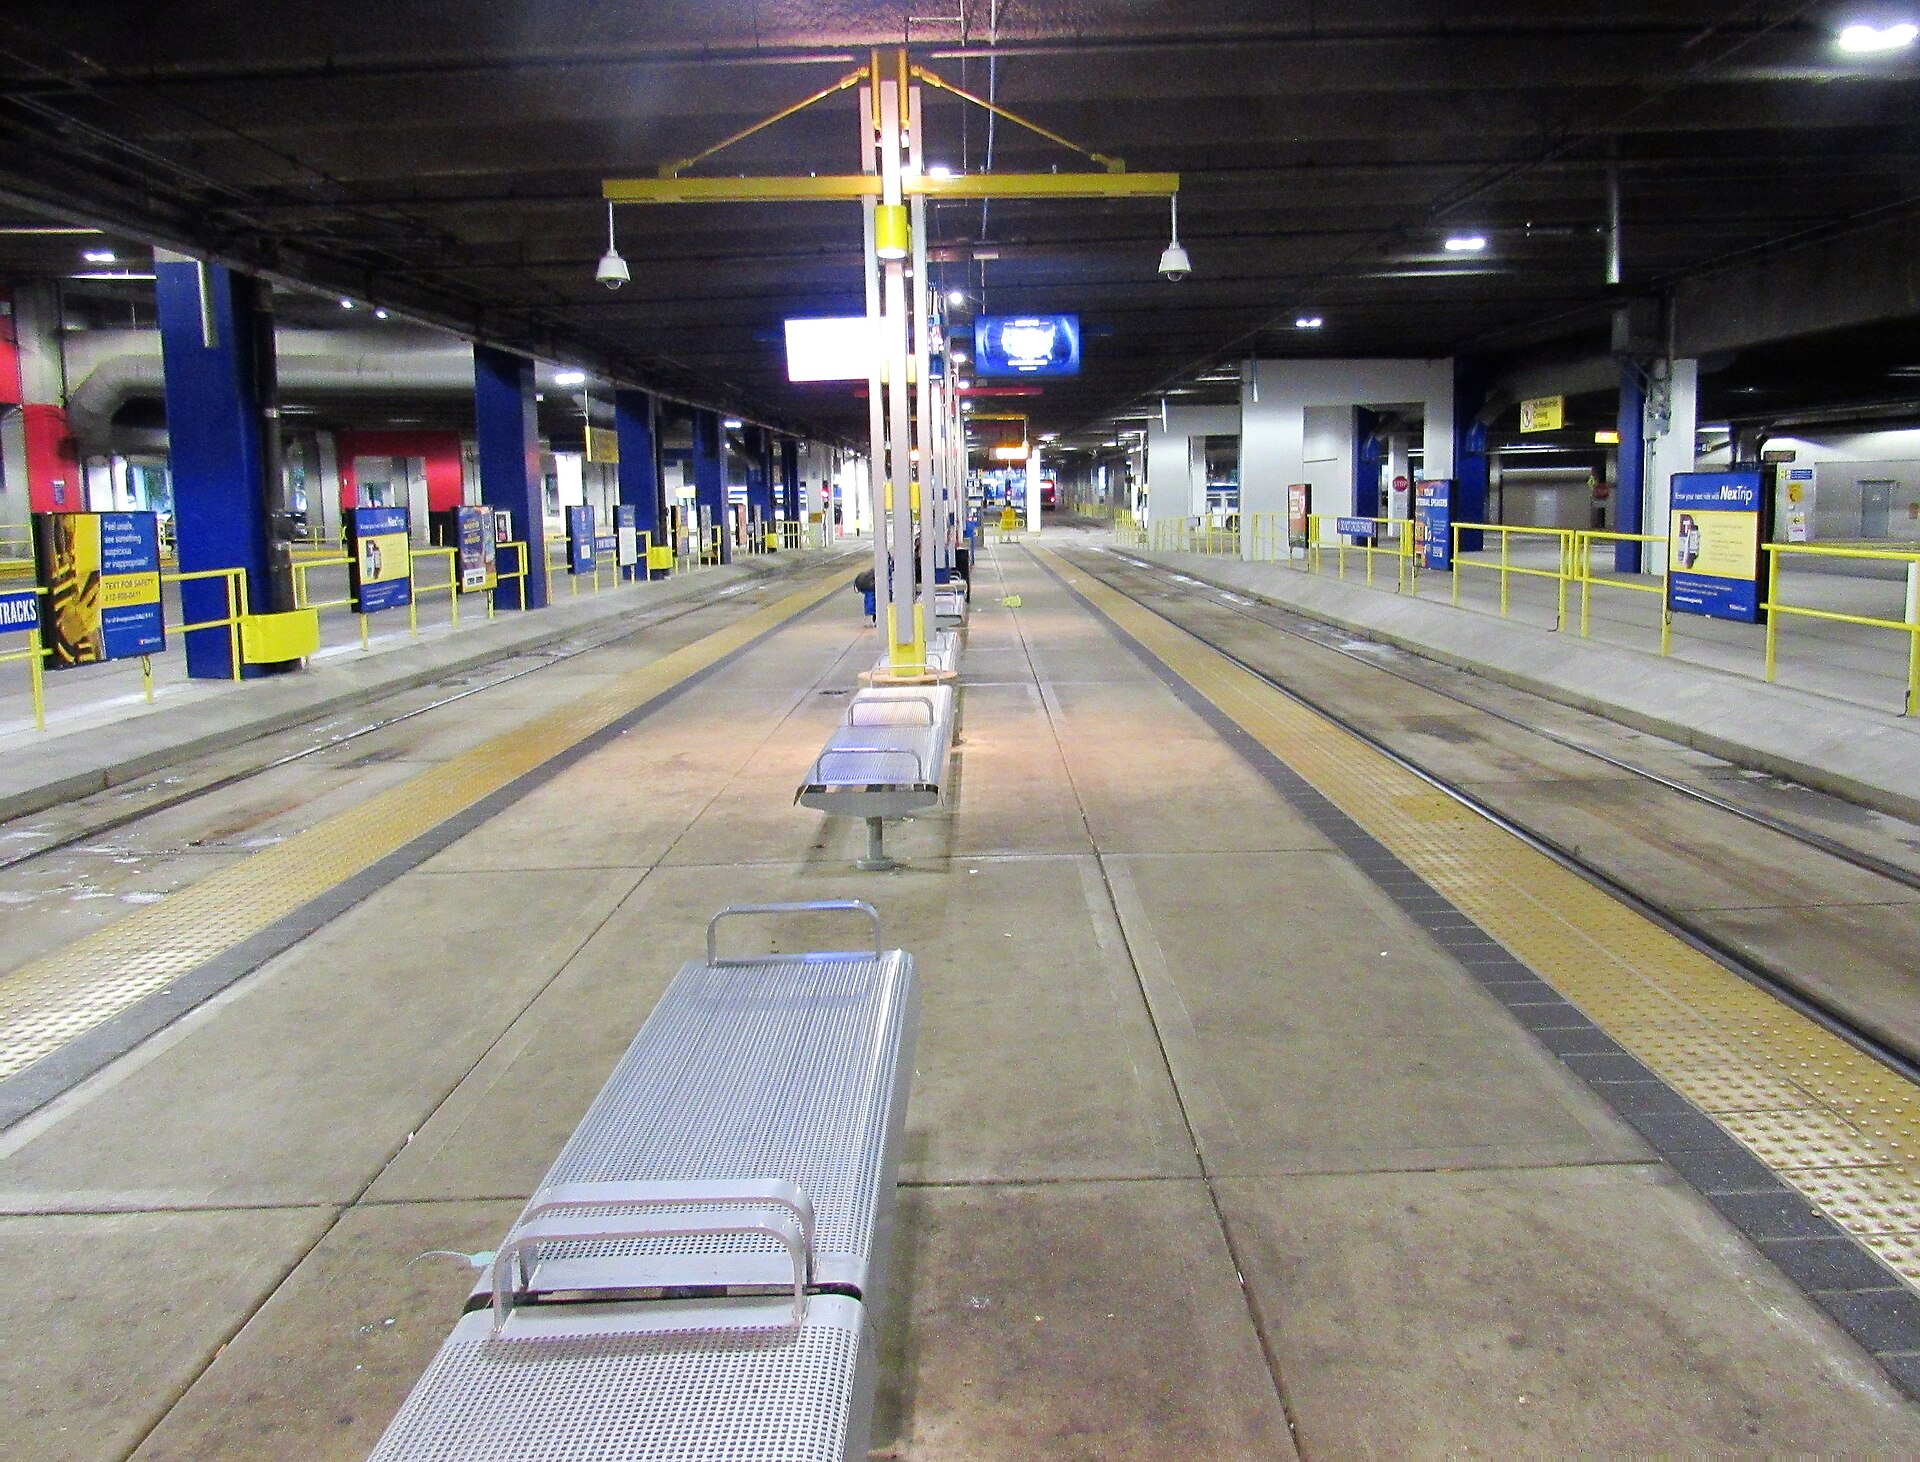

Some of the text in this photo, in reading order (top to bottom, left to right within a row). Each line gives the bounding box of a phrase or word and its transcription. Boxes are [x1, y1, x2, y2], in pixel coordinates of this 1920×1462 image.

[1394, 480, 1407, 488] STOP
[1720, 486, 1753, 506] NexTrip
[104, 522, 116, 530] Feel
[116, 535, 142, 545] something
[104, 548, 133, 558] suspicious
[104, 578, 154, 590] TEXT FOR SAFETY
[0, 599, 36, 625] TRACKS
